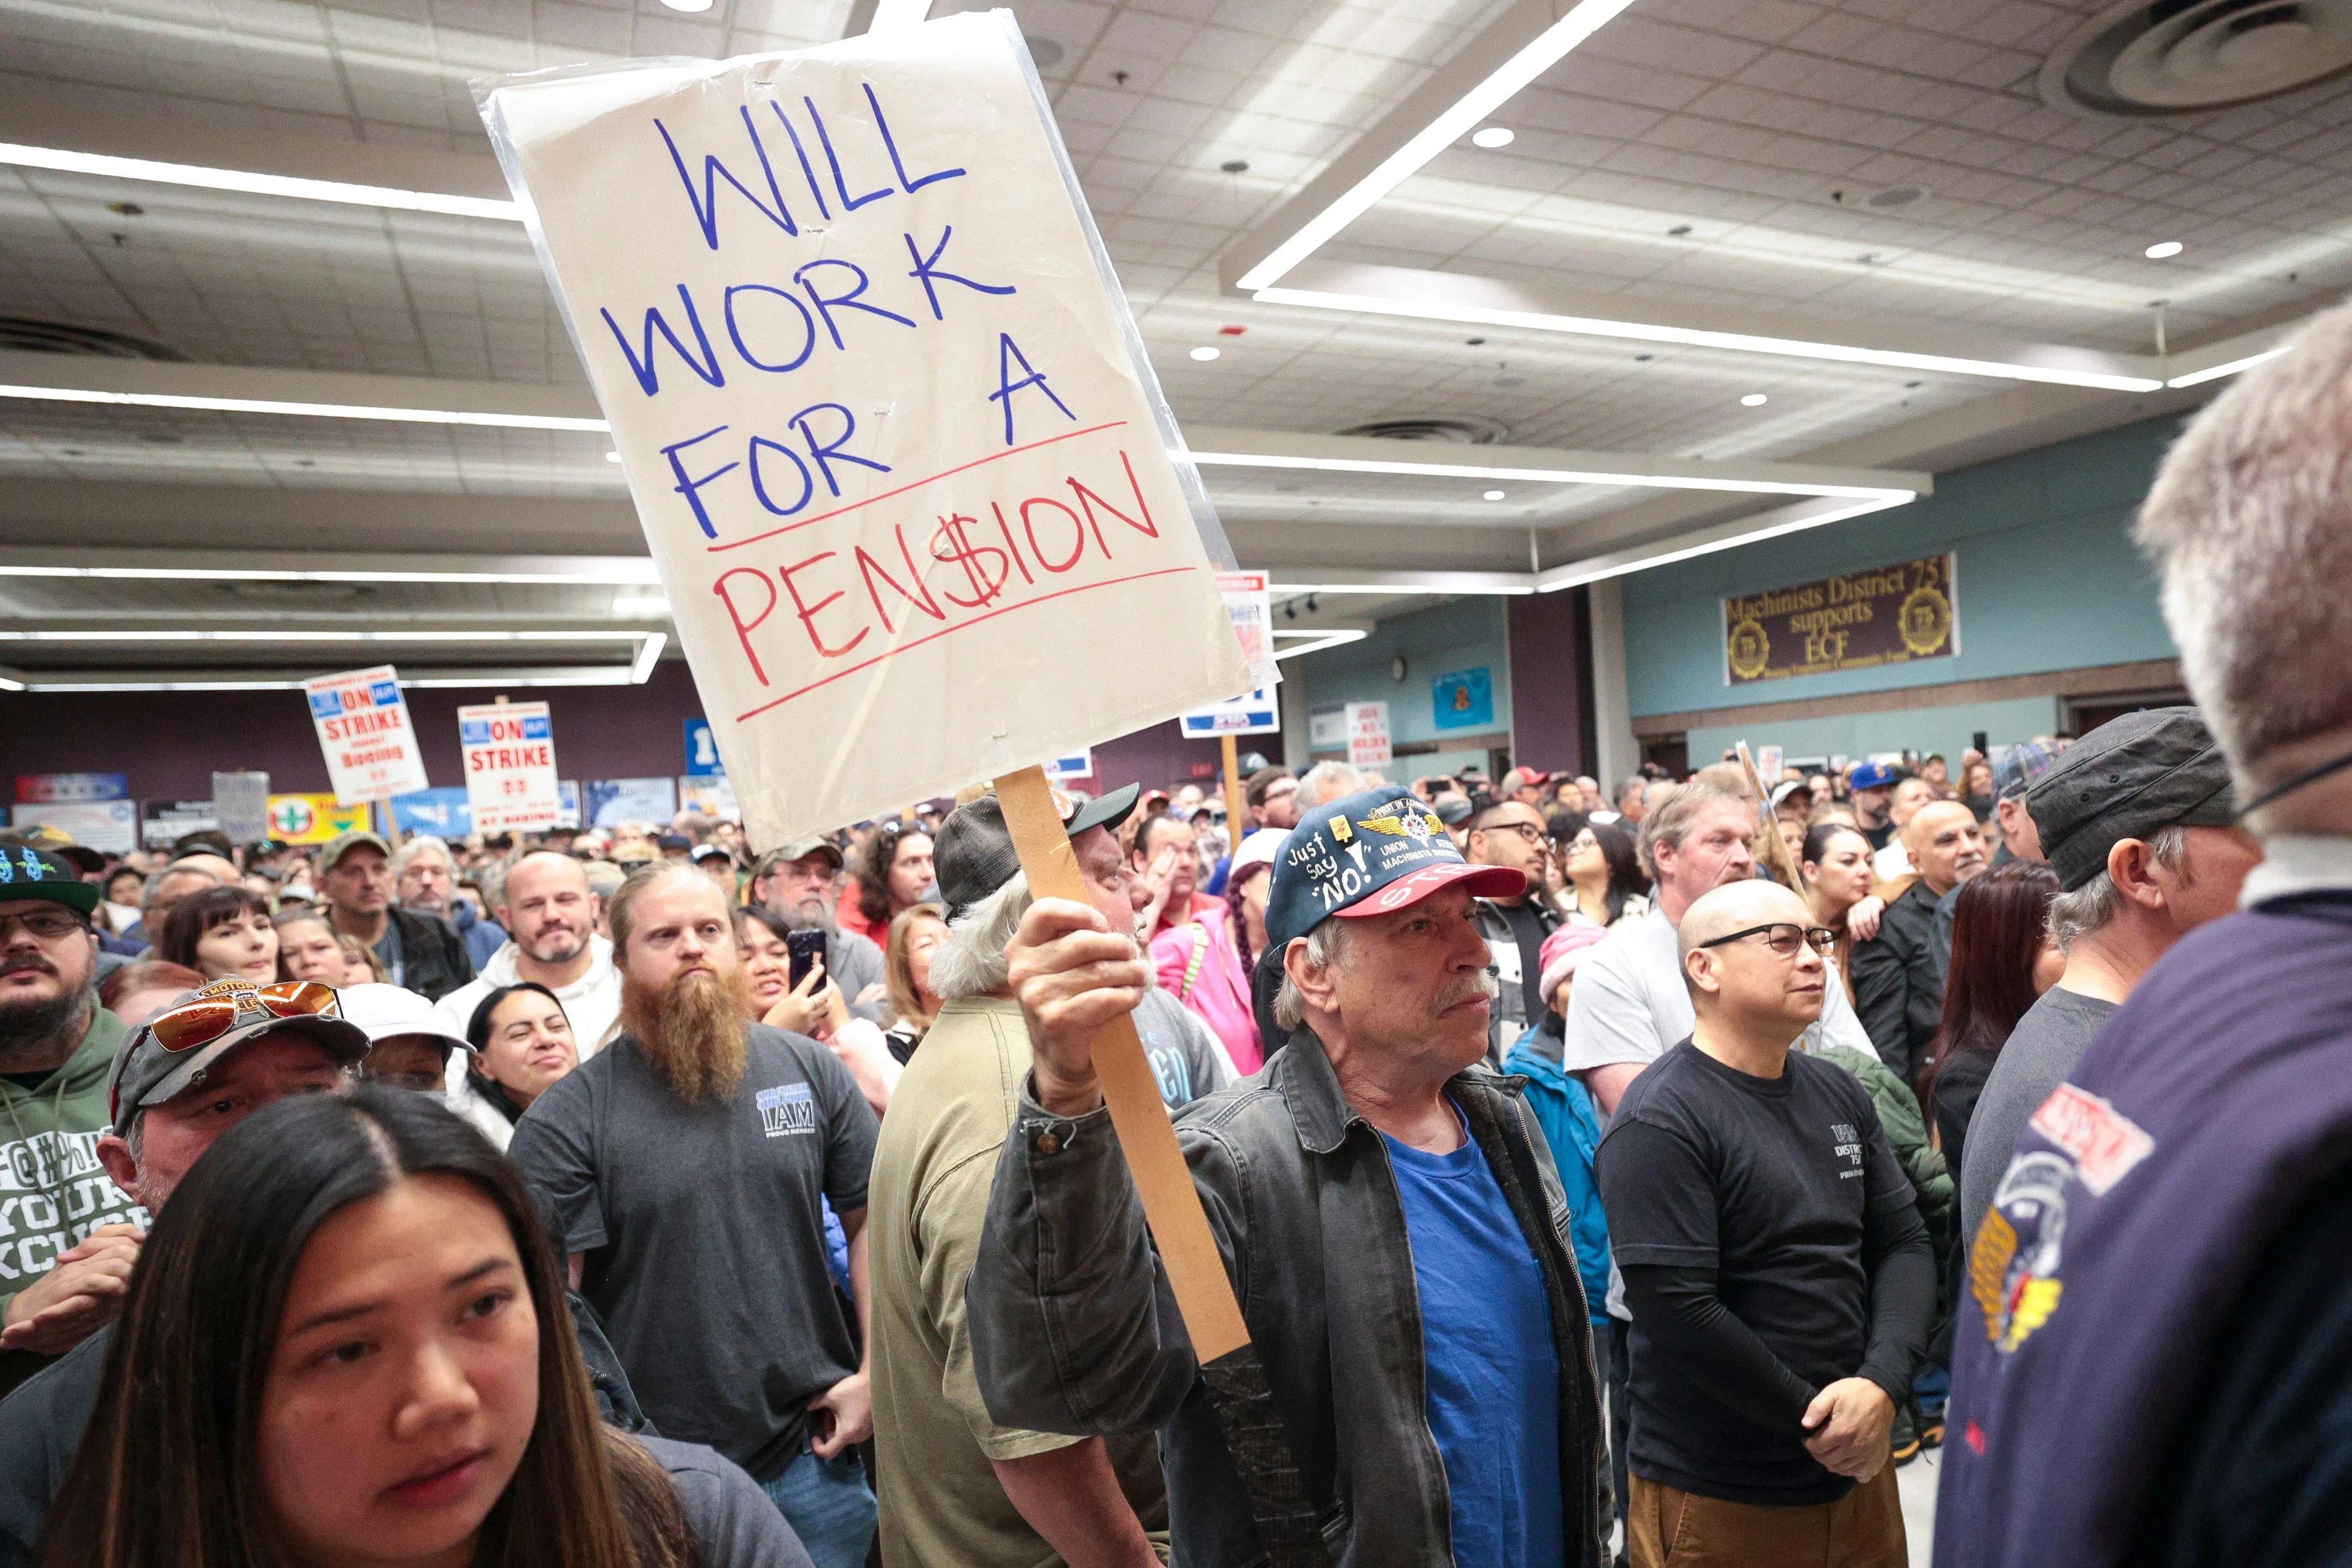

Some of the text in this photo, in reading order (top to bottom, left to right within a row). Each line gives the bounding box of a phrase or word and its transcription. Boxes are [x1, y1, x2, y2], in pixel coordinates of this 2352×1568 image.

[653, 82, 967, 251] WILL
[600, 225, 1017, 397] WORK
[660, 333, 1077, 538] FOR A
[1725, 587, 1824, 620] Machinists
[1829, 570, 1905, 602] District
[1789, 600, 1873, 638] supports
[1805, 631, 1849, 664] ECF
[342, 688, 372, 711] ON
[324, 709, 402, 741] STRIKE
[491, 720, 522, 741] ON
[471, 746, 549, 772] STRIKE
[1380, 840, 1409, 856] UNION
[1382, 849, 1433, 870] MACHINISTS
[209, 982, 255, 995] MOTOR
[761, 1099, 815, 1132] IAM
[766, 1129, 790, 1138] PROUD
